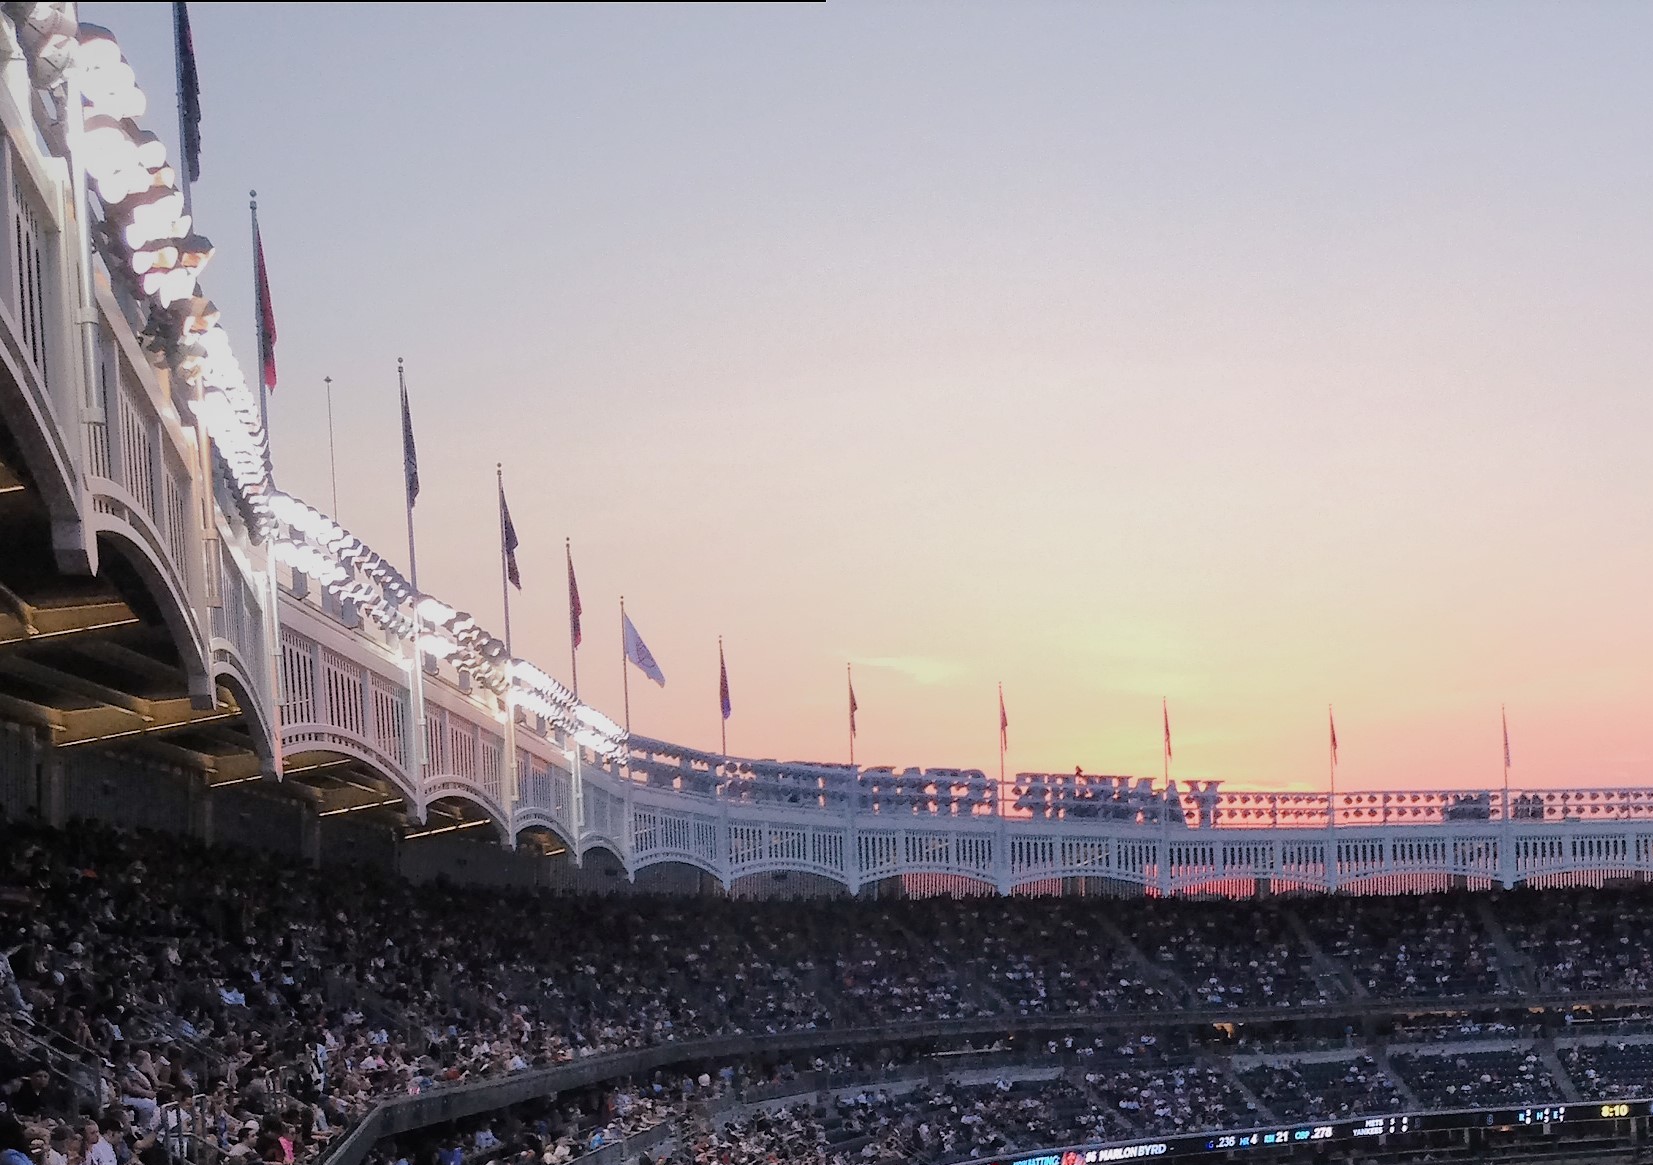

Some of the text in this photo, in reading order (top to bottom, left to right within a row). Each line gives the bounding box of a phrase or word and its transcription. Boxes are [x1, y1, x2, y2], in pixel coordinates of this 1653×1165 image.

[1600, 1104, 1629, 1118] 8:10
[1216, 1136, 1235, 1148] .236
[1250, 1134, 1258, 1144] 4
[1276, 1132, 1288, 1143] 21
[1099, 1146, 1137, 1162] MARLON
[1137, 1143, 1167, 1157] BYRD
